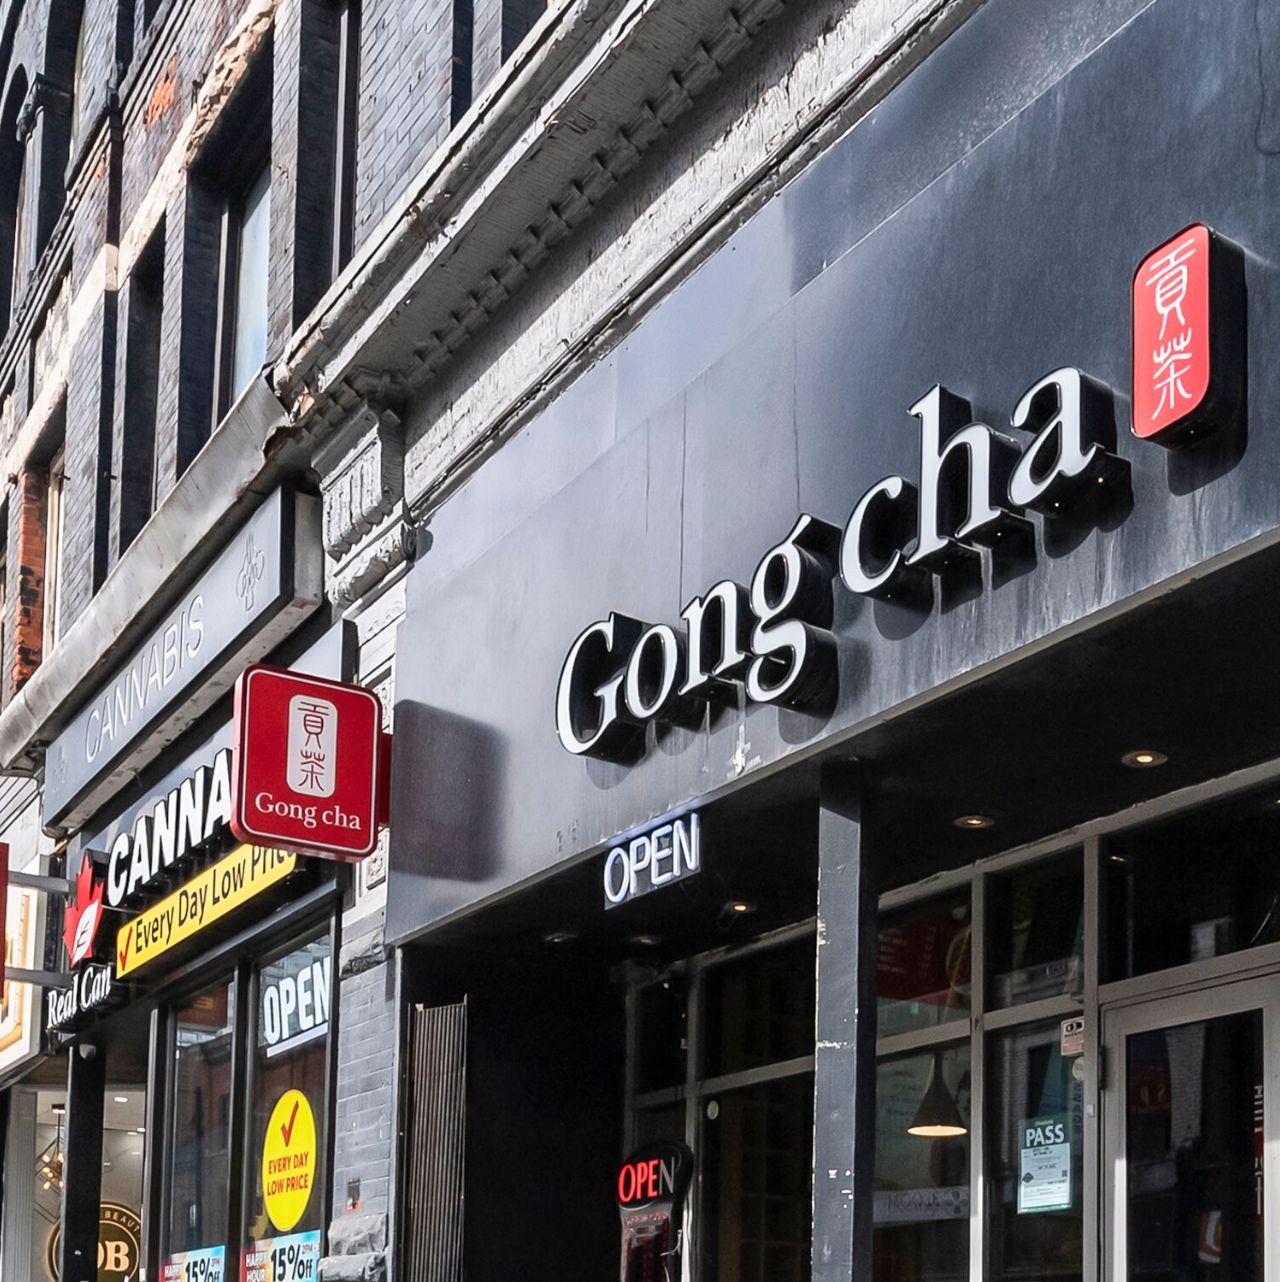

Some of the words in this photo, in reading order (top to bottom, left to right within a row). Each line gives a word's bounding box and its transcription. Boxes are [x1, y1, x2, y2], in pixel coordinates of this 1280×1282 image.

[556, 514, 814, 756] Gong
[838, 366, 1105, 597] cha
[84, 594, 204, 763] CANNABIS
[107, 748, 231, 907] CANNA
[255, 792, 317, 828] Gong
[322, 805, 361, 830] cha
[603, 813, 700, 903] OPEN
[135, 906, 175, 954] Every
[178, 884, 208, 926] Day
[212, 853, 247, 905] Low
[46, 973, 79, 1029] Real
[81, 966, 112, 1008] Can
[263, 956, 331, 1044] OPEN
[1025, 1123, 1065, 1147] PASS
[267, 1178, 285, 1197] LOW
[286, 1173, 309, 1193] PRICE
[268, 1154, 292, 1175] EVERY
[293, 1151, 309, 1168] DAY
[618, 1156, 675, 1203] OPEN
[104, 1211, 140, 1232] BEAUT
[271, 1243, 301, 1282] 15%
